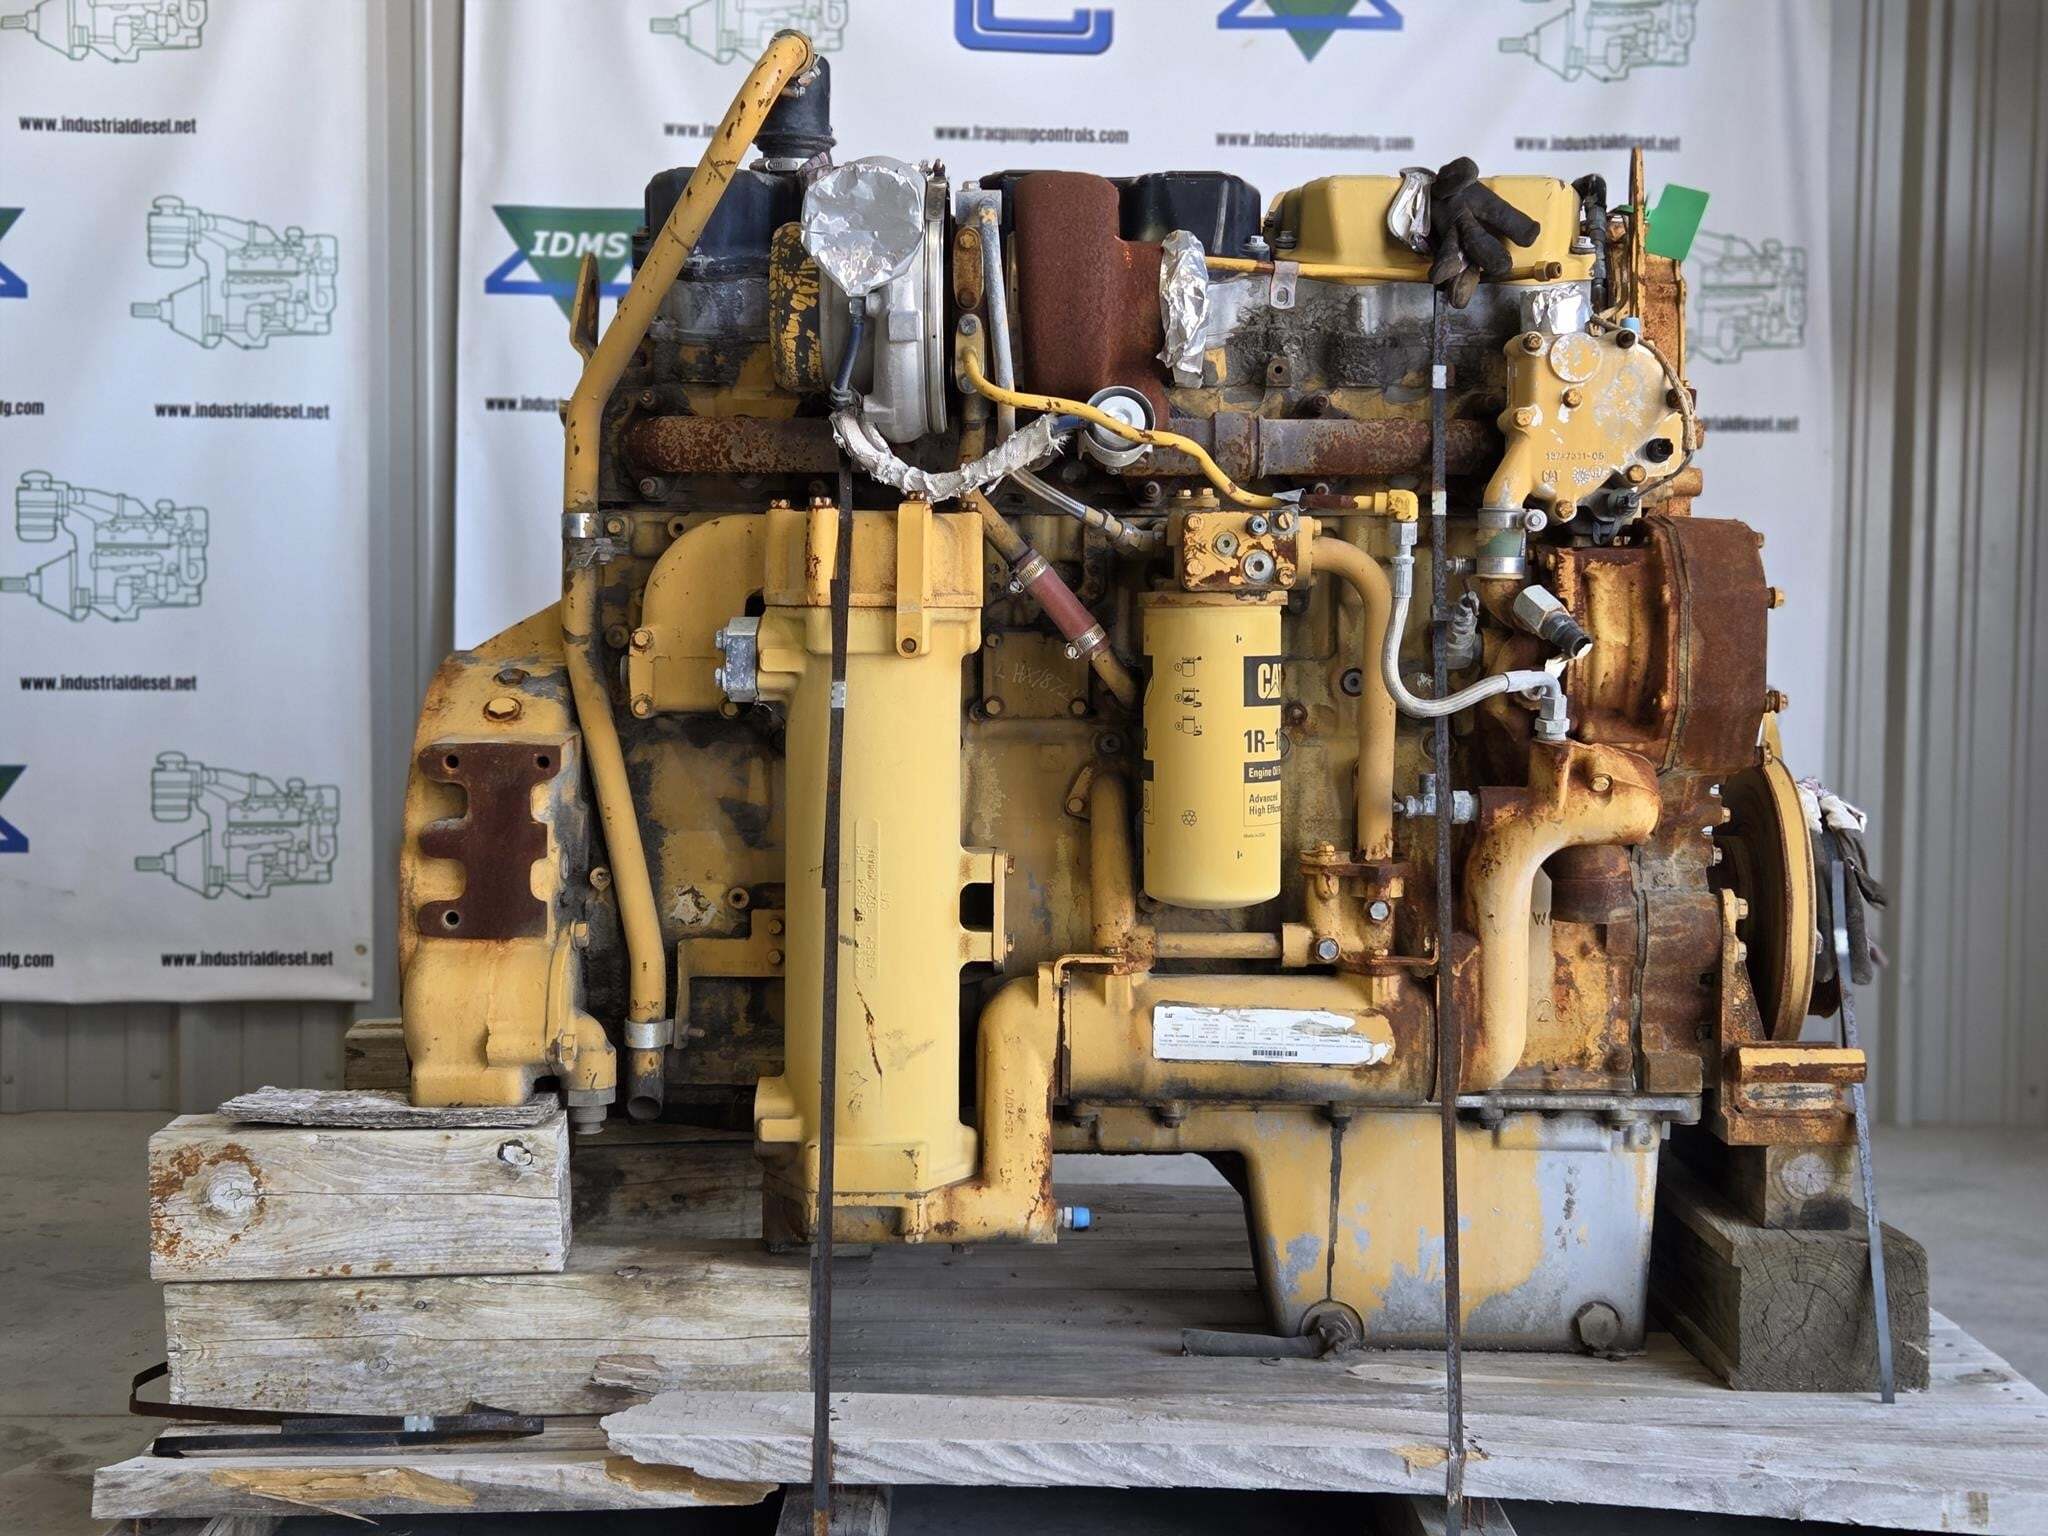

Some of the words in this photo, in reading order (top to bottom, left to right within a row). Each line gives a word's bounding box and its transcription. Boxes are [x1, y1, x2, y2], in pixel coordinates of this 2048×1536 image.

[19, 116, 197, 136] www.industrialdiesel.net
[934, 126, 1130, 145] www.tracpumpcontrols.com
[529, 230, 629, 259] IDMS
[154, 402, 331, 421] www.industrialdiesel.net
[20, 675, 197, 692] www.industrialdiesel.net
[1257, 663, 1281, 700] CA
[1248, 767, 1272, 779] Engine
[1249, 806, 1266, 816] High
[161, 950, 334, 967] www.industrialdiesel.net
